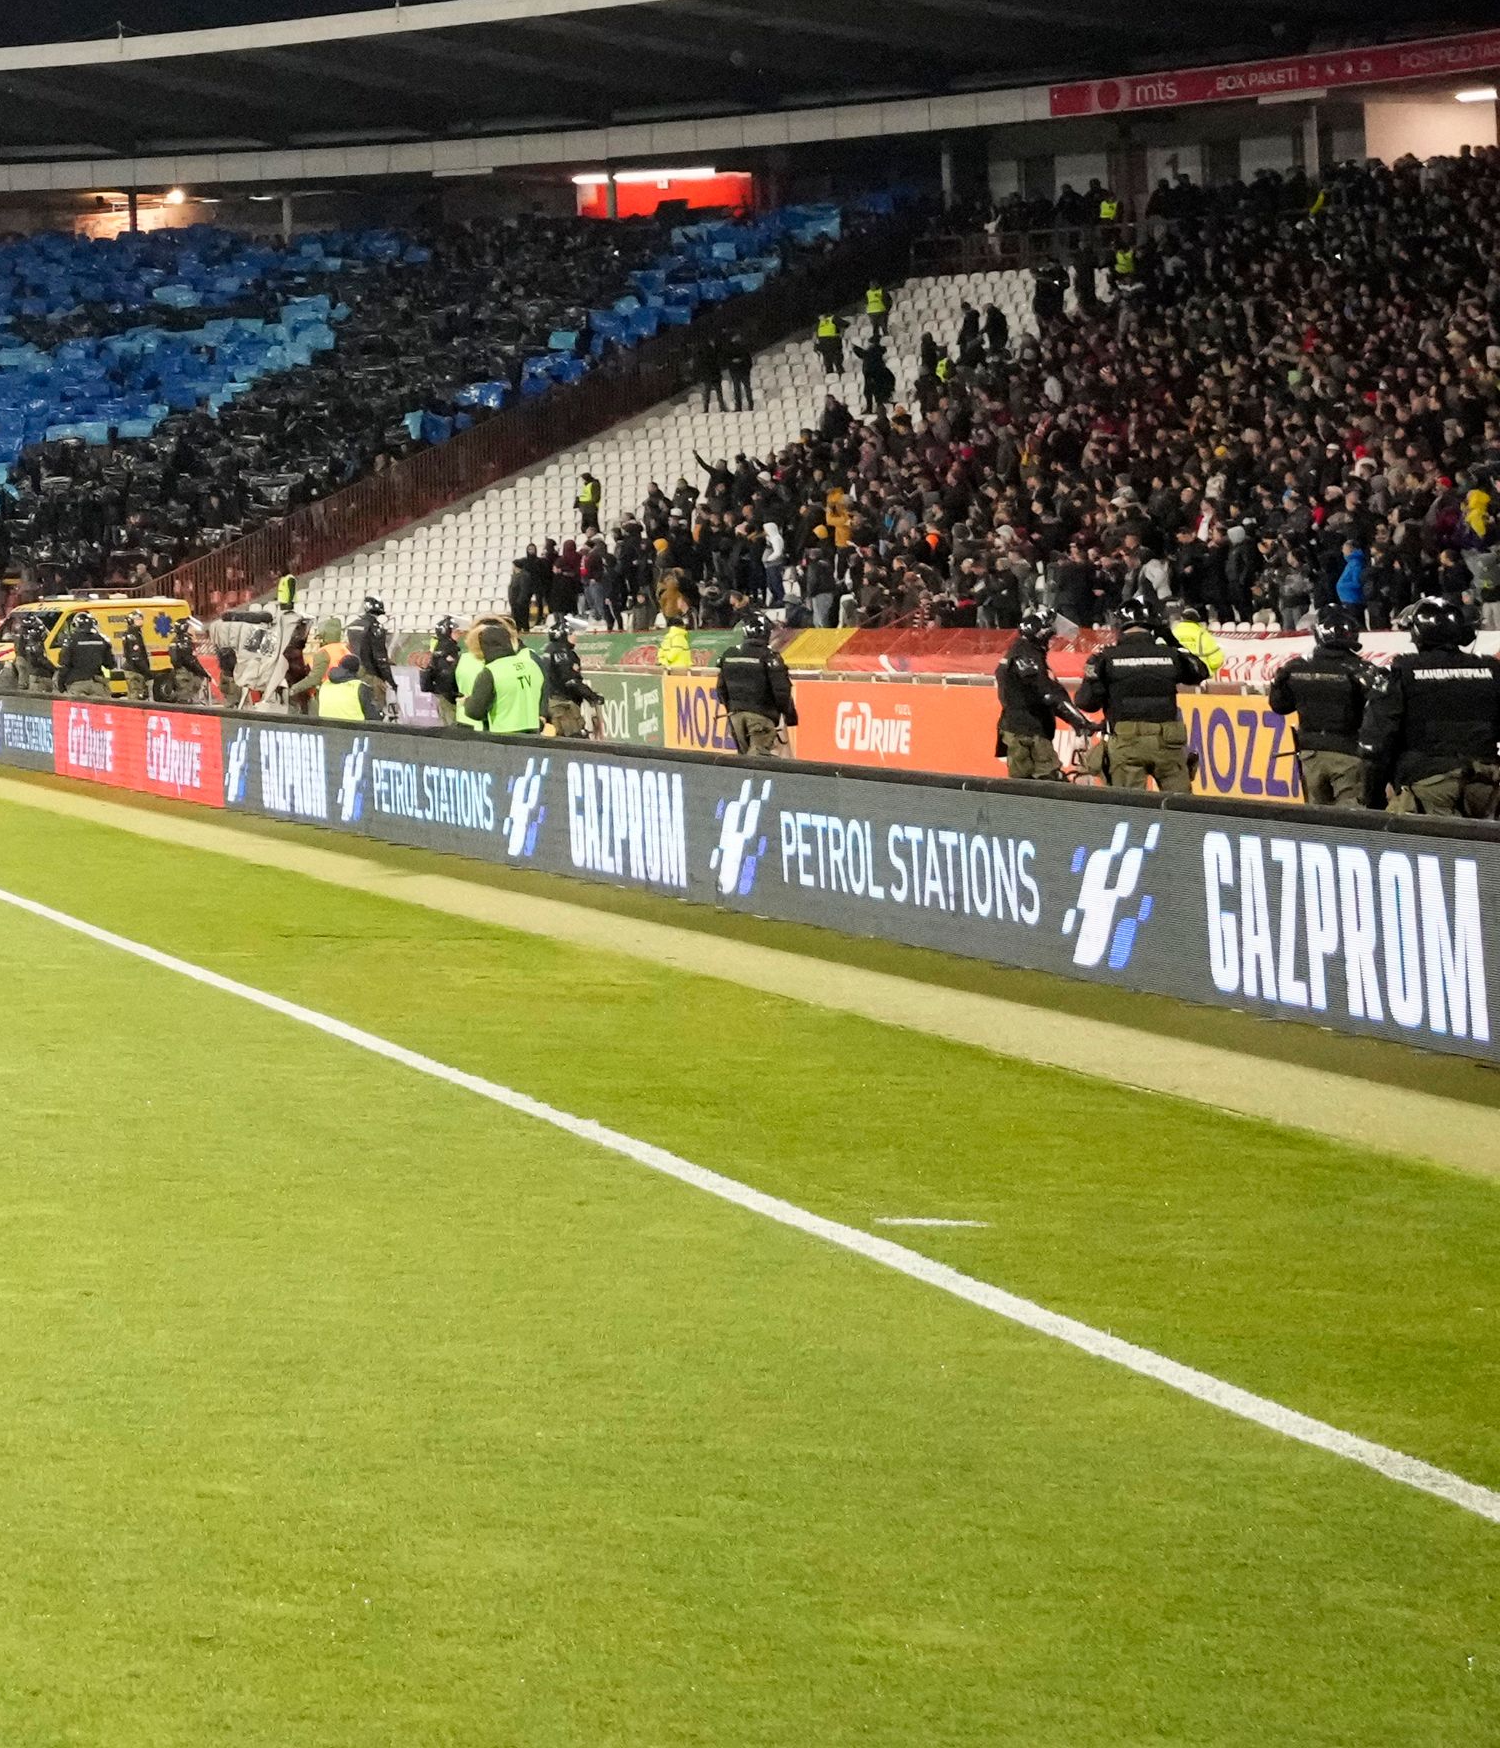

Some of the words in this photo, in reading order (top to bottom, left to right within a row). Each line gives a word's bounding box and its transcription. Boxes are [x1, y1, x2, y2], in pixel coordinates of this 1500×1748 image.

[1134, 77, 1179, 107] mts
[1215, 72, 1246, 93] BOX
[517, 675, 531, 689] TV
[259, 729, 328, 819] GAZPROM
[372, 759, 423, 819] PETROL
[423, 765, 494, 831] STATIONS
[567, 762, 688, 888] GAZPROM
[780, 810, 885, 900] PETROL
[888, 822, 1041, 926] STATIONS
[1202, 831, 1489, 1042] GAZPROM
